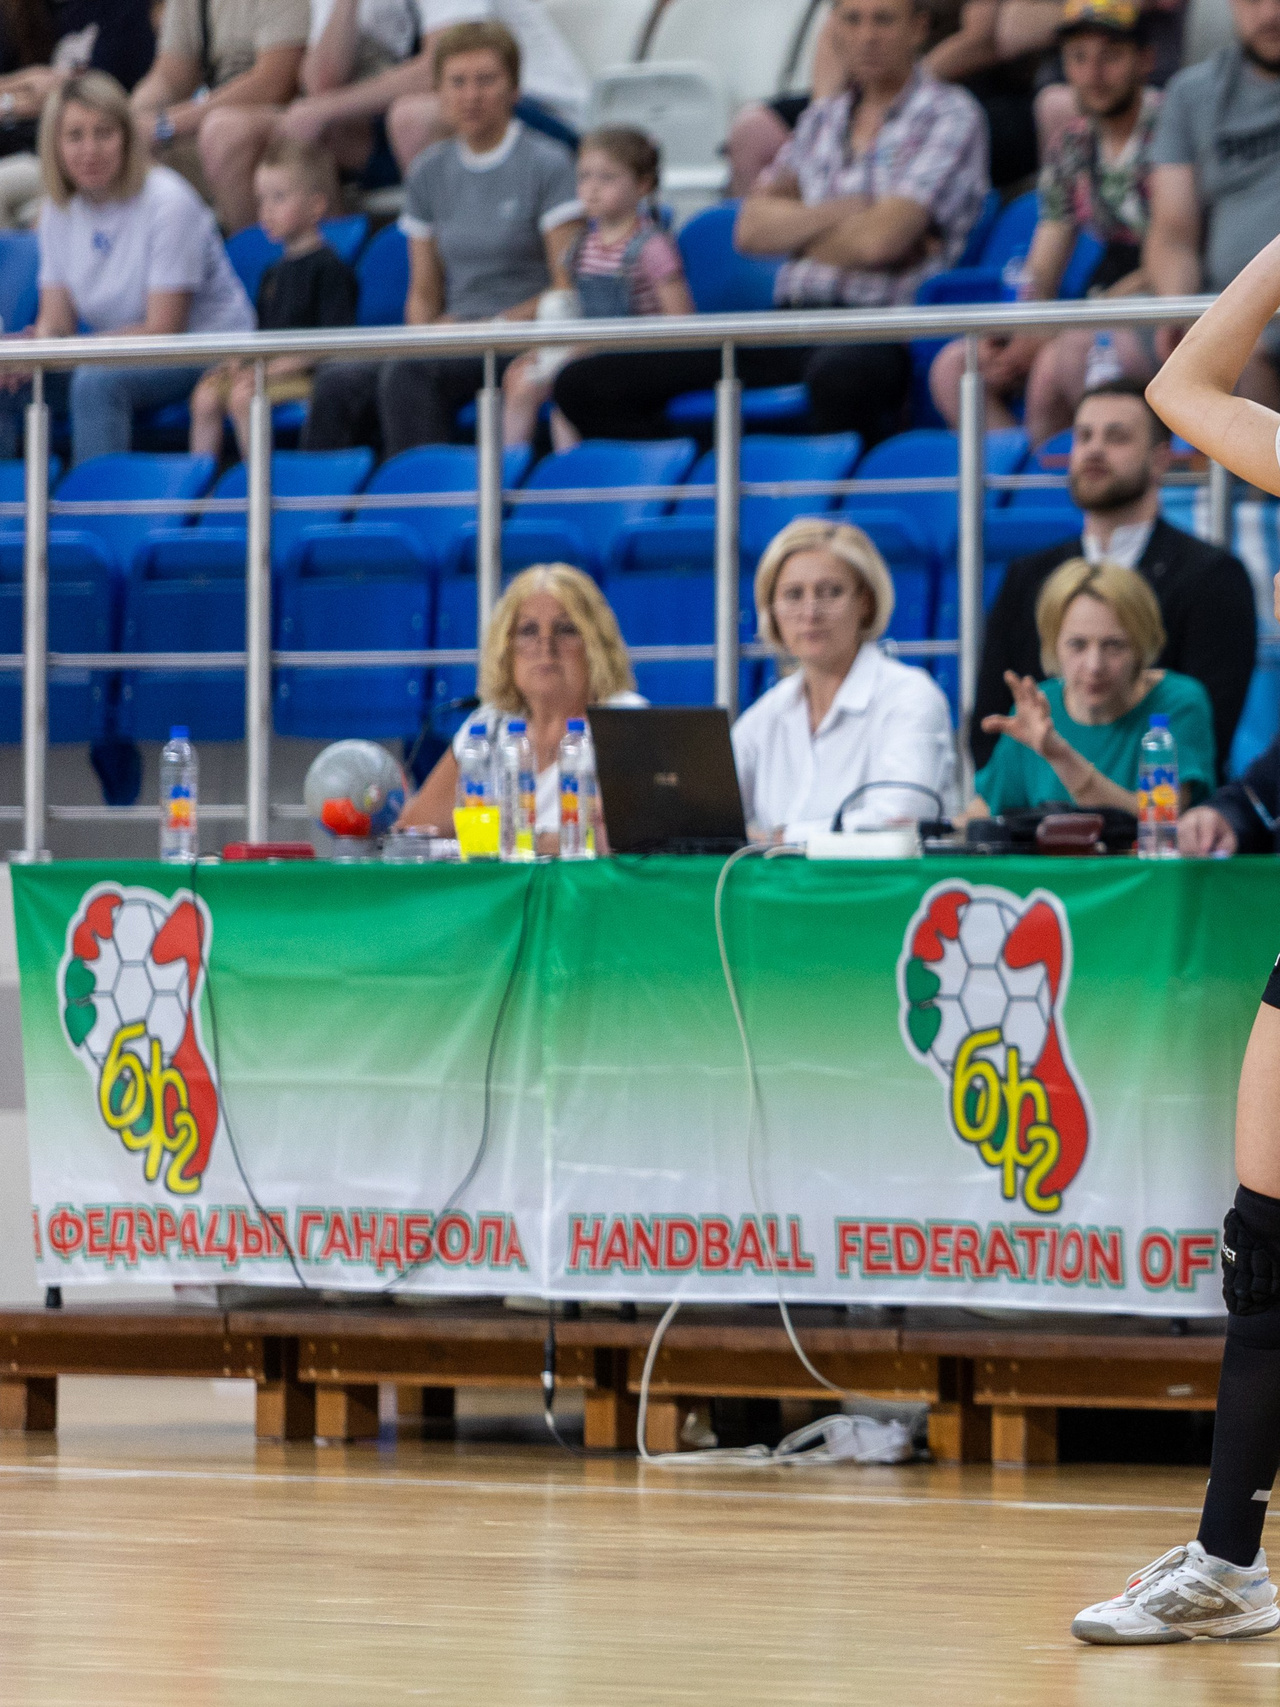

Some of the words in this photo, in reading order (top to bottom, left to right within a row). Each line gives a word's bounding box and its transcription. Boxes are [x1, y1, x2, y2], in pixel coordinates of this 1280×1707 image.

[297, 1206, 529, 1277] ГАНДБОЛА
[566, 1213, 815, 1276] HANDBALL
[835, 1217, 1126, 1290] FEDERATION
[1140, 1227, 1219, 1293] OF
